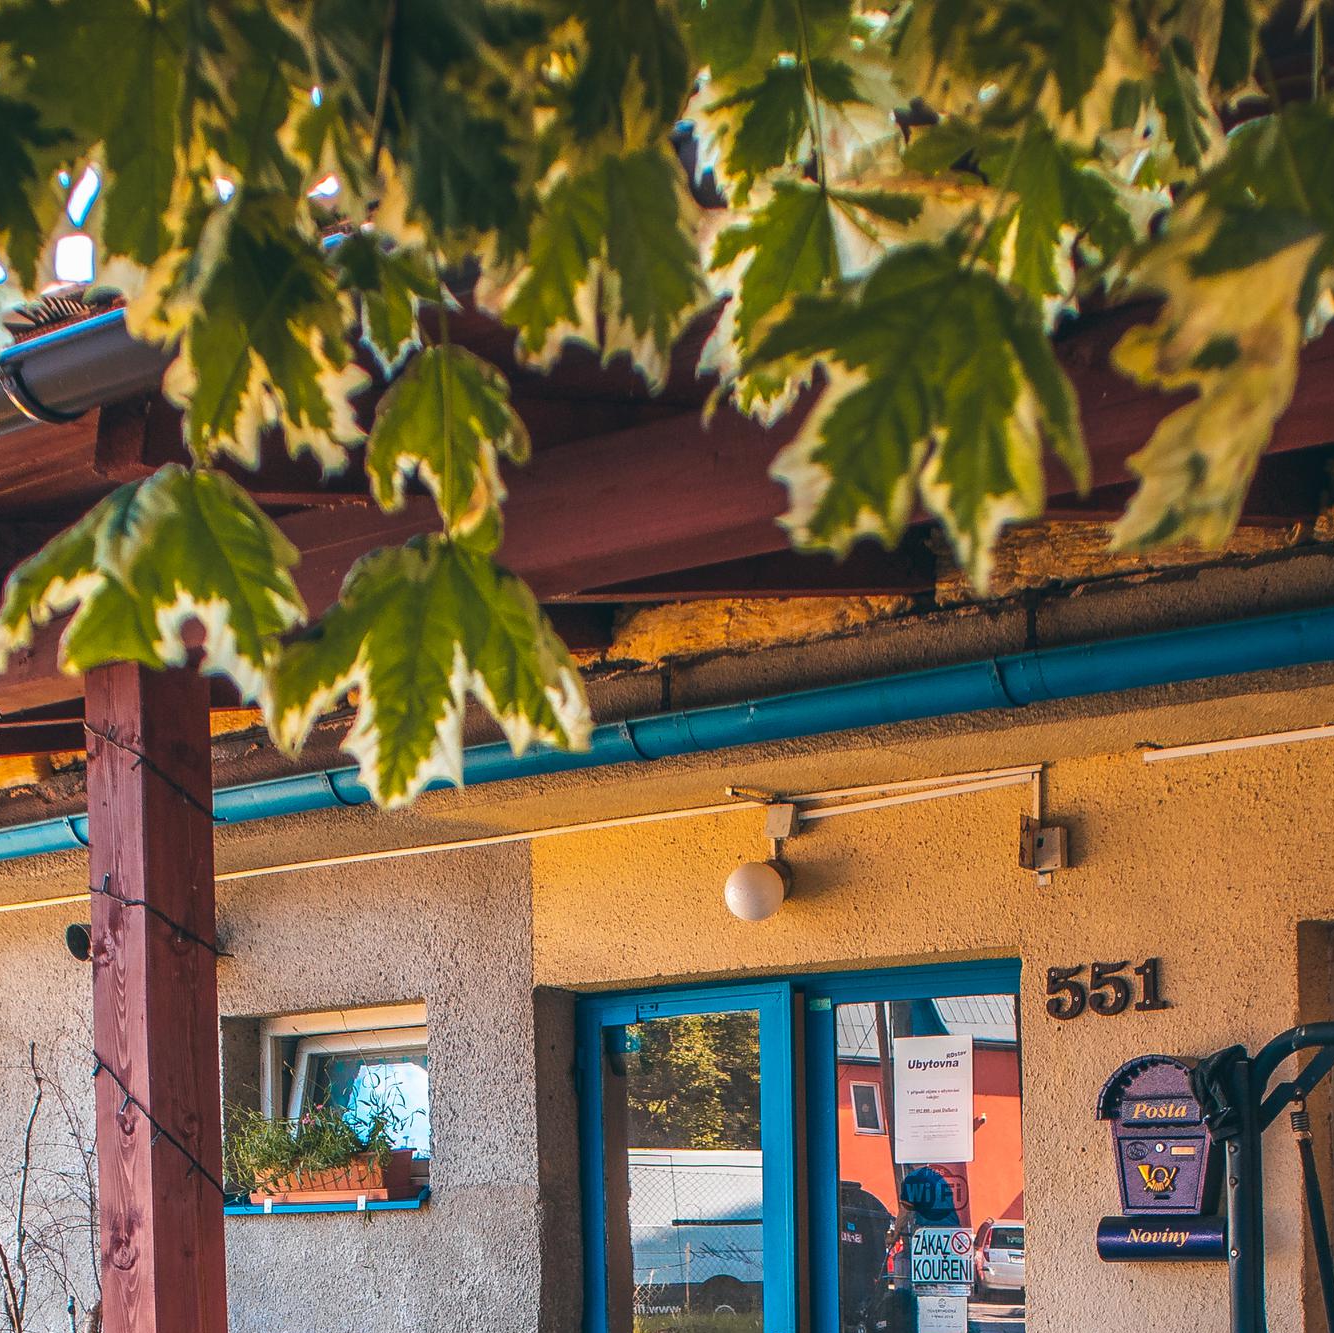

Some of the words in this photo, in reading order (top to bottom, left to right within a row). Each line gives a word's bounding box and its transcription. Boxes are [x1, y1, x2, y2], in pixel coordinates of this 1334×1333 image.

[1046, 957, 1169, 1020] 551
[908, 1059, 959, 1071] Ubytovna
[914, 1230, 951, 1255] ZÁKAZ
[1126, 1228, 1189, 1247] Noviny
[914, 1255, 973, 1280] KOUŘENÍ
